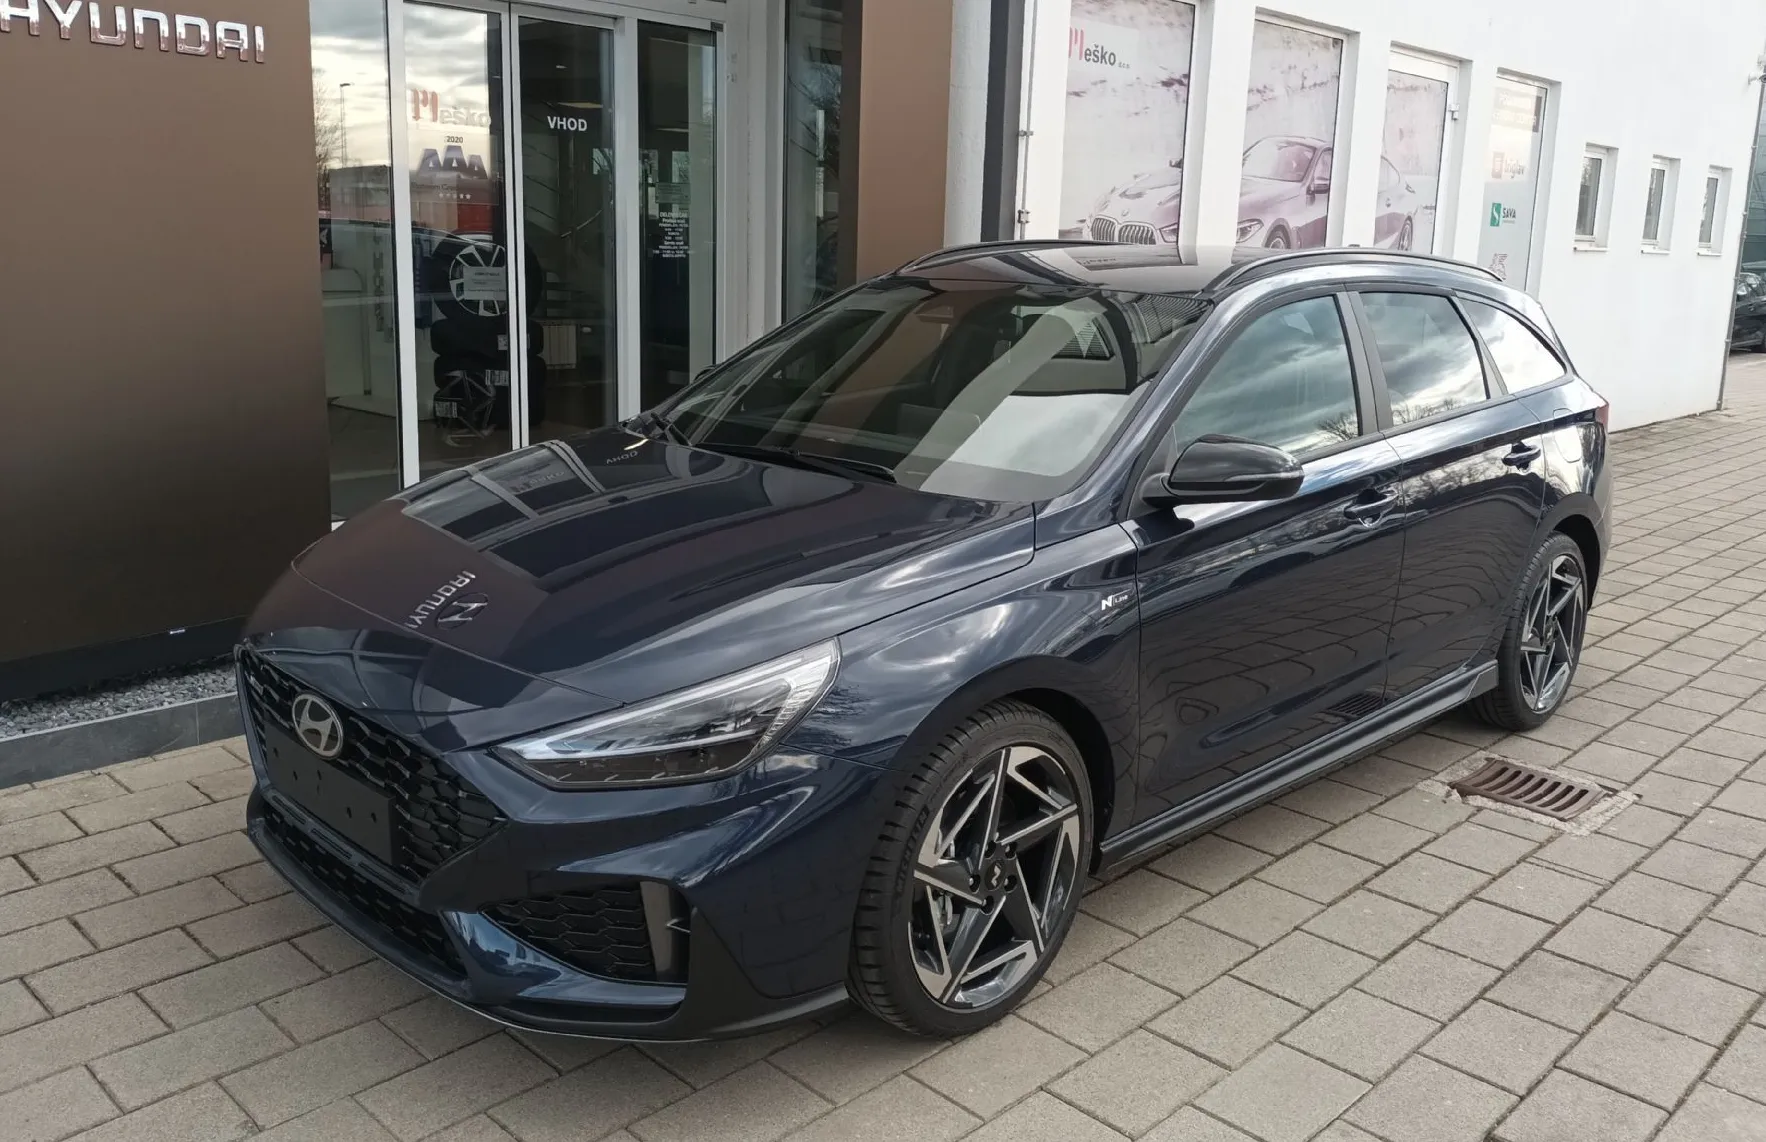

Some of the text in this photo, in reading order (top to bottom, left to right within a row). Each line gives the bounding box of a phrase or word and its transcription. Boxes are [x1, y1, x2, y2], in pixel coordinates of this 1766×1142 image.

[0, 0, 265, 63] HYUNDAI
[547, 116, 587, 131] VHOD
[446, 135, 463, 143] 2020
